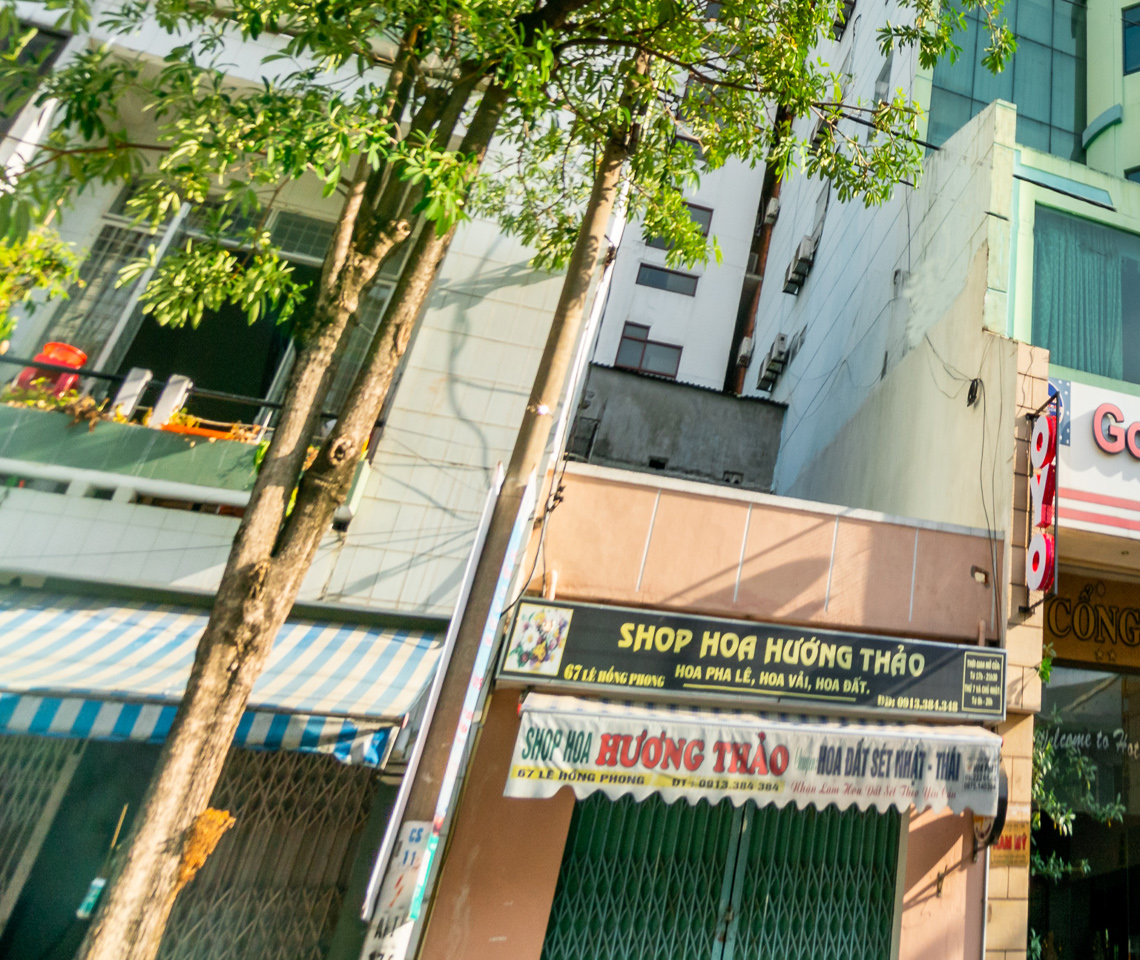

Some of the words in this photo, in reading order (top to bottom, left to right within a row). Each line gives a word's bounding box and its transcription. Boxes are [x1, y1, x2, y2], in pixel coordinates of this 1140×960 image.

[617, 622, 693, 653] SHOP
[700, 630, 758, 662] HOA
[860, 645, 926, 677] THẢO
[564, 663, 581, 681] 67
[628, 674, 665, 687] PHONG
[675, 664, 702, 679] HOA
[705, 666, 731, 682] PHA
[735, 667, 756, 686] LÊ,
[759, 671, 785, 688] HOA
[815, 679, 840, 694] HOA
[521, 726, 563, 763] SHOP
[563, 730, 592, 764] HOA
[712, 731, 790, 776] THẢO
[816, 745, 842, 776] HOA
[871, 743, 893, 779] SÉT
[1096, 730, 1109, 750] to
[517, 768, 536, 779] 67
[599, 773, 645, 785] PHONG
